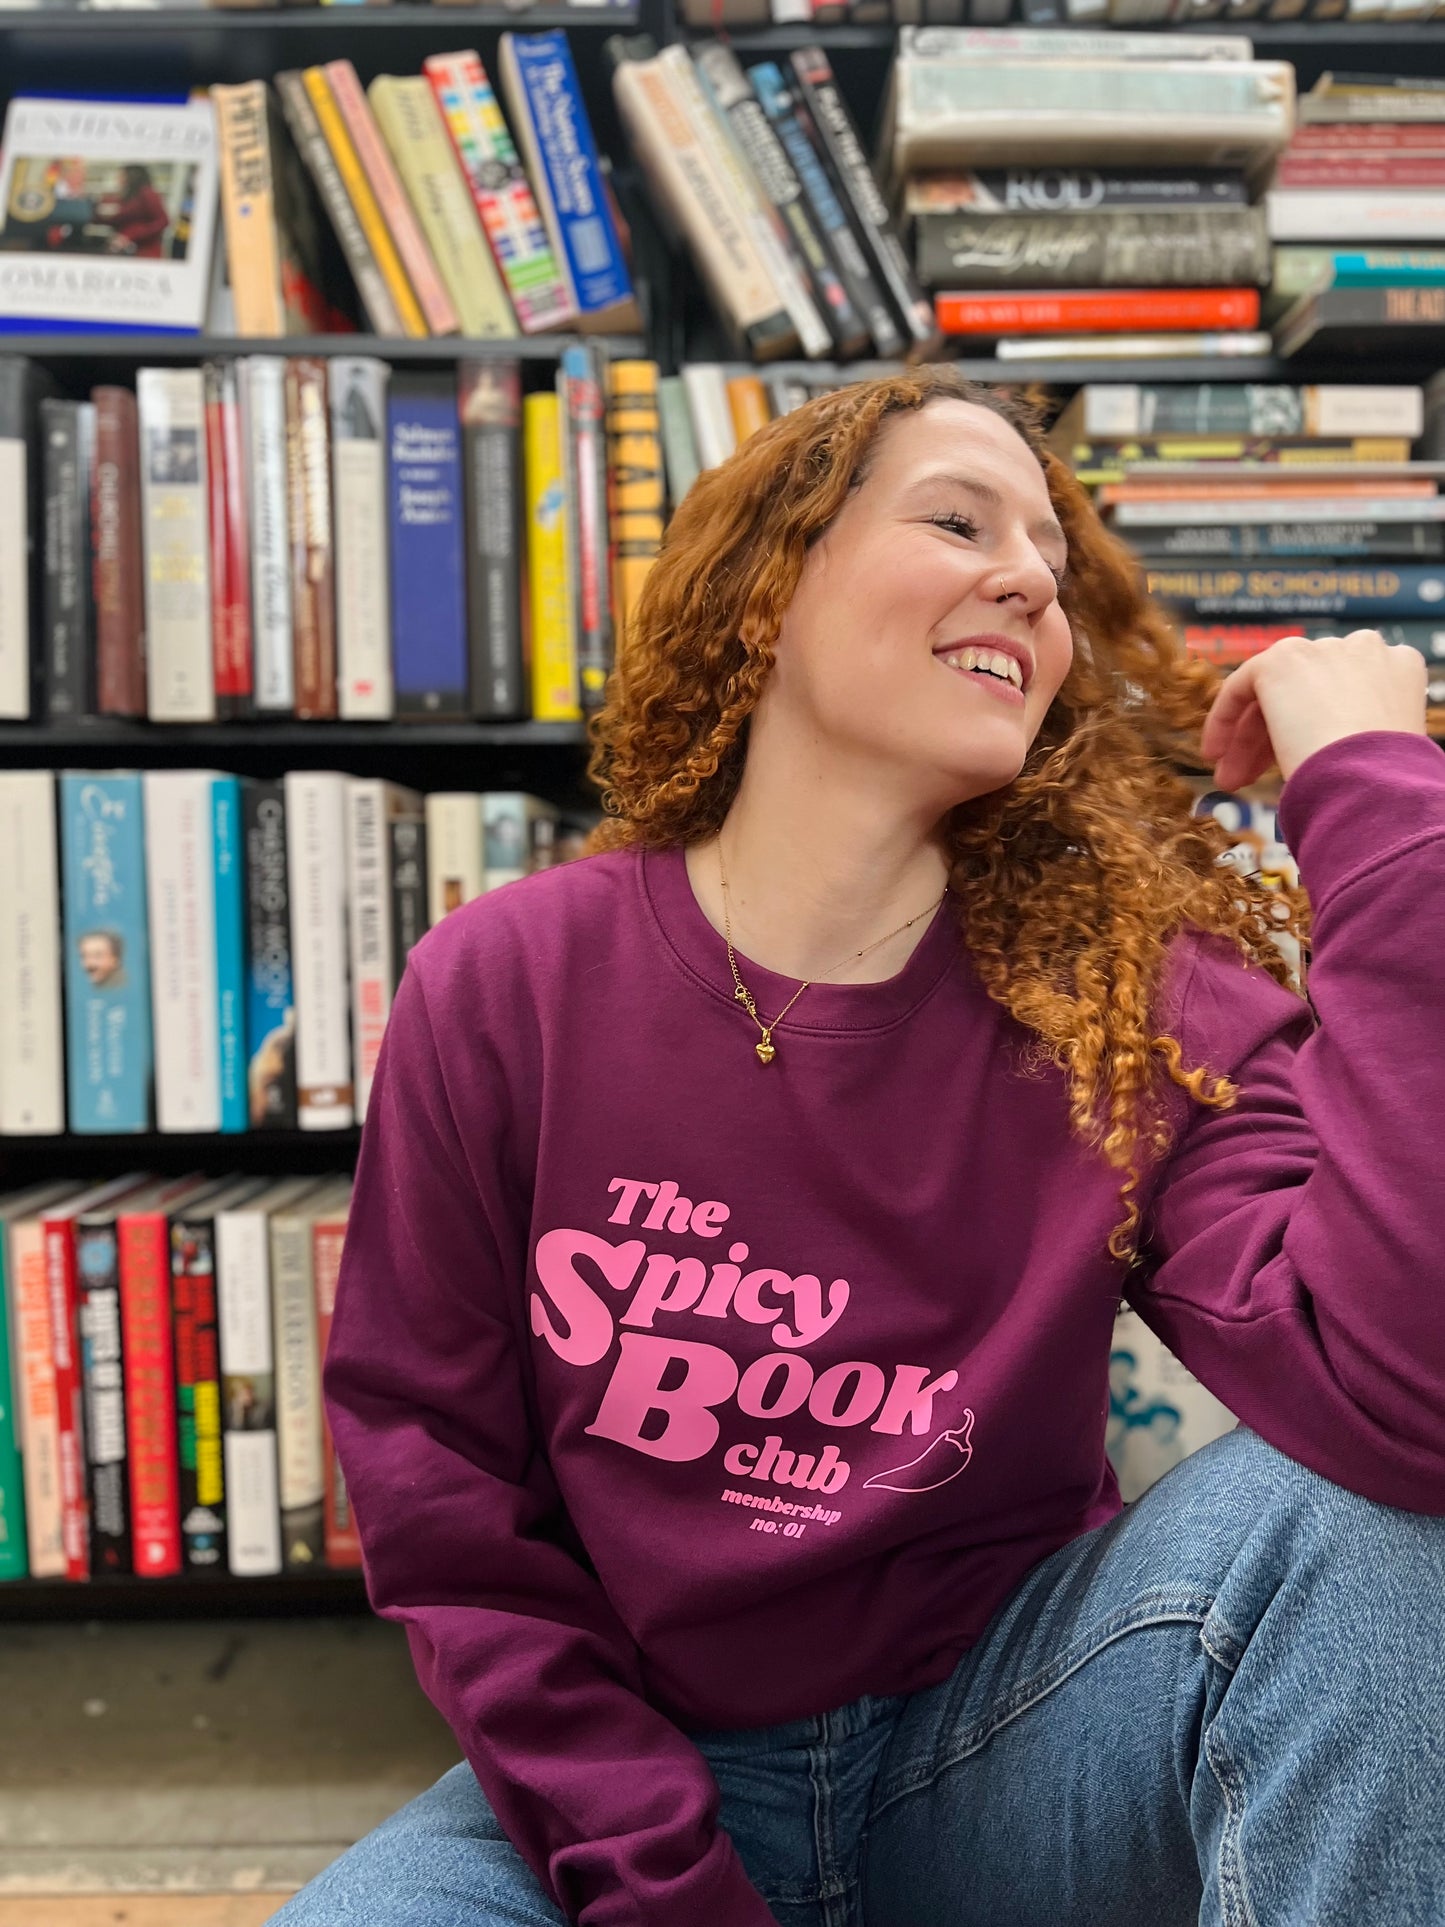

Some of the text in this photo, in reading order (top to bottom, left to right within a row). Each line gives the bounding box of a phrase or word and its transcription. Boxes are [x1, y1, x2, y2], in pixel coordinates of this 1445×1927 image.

[13, 110, 212, 149] UNHINGED
[1004, 168, 1105, 209] ROD
[2, 266, 173, 299] OMAROSA
[1146, 569, 1401, 598] PHILLIP SCHOFIELD
[257, 799, 286, 912] CHASING
[607, 1177, 730, 1237] The
[530, 1228, 850, 1366] Spicy
[136, 1367, 170, 1505] FOWLER
[723, 1436, 851, 1494] club
[721, 1487, 842, 1526] membership
